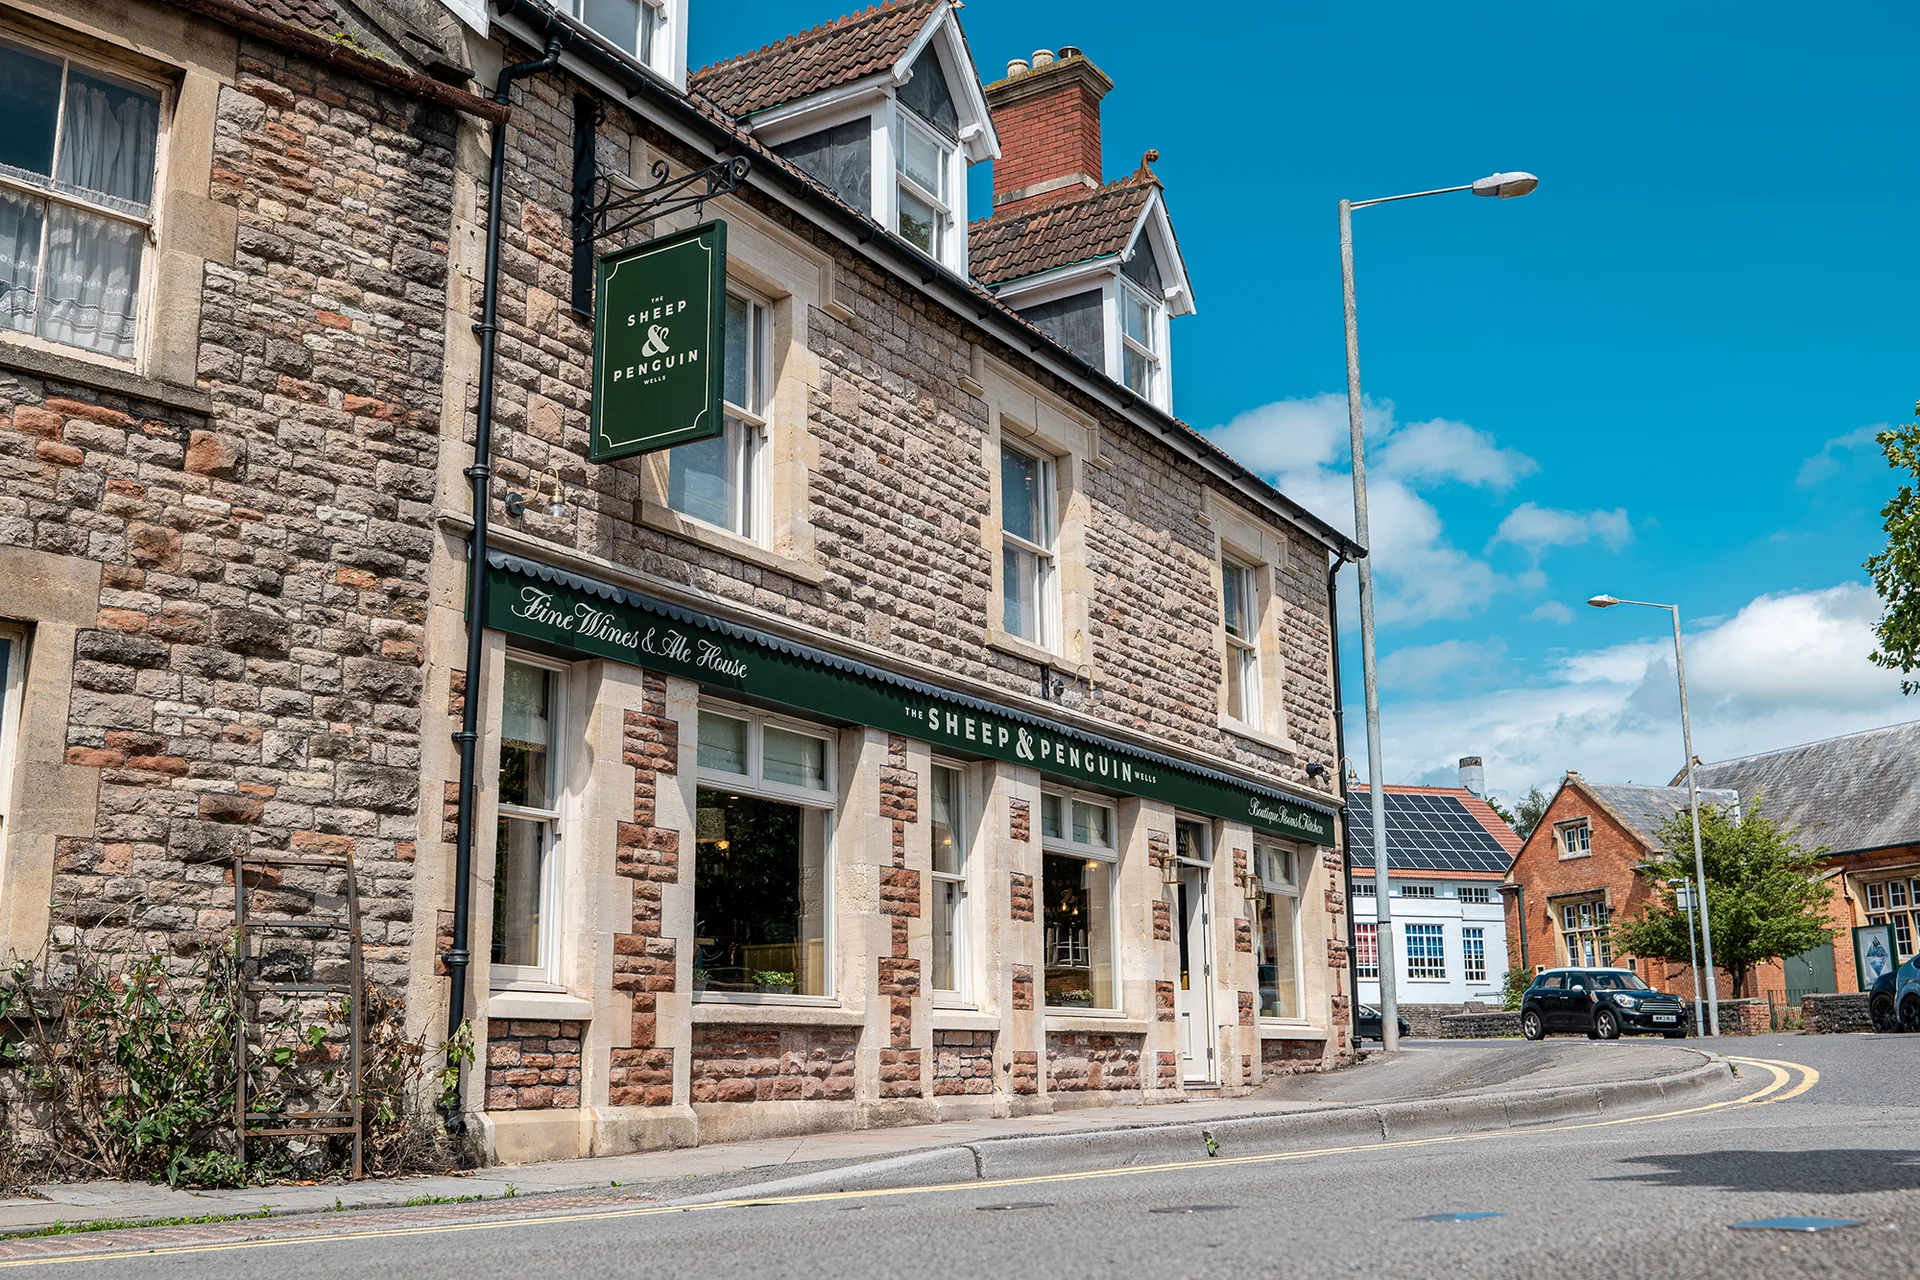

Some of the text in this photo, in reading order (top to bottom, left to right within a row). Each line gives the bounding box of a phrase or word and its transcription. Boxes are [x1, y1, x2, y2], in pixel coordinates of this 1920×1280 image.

[627, 300, 687, 327] SHEEP
[651, 295, 664, 303] THE
[641, 324, 670, 358] &
[613, 349, 698, 382] PENGUIN
[643, 375, 666, 385] WELLS
[511, 585, 748, 679] Fine Wines & Ale House
[905, 706, 1157, 784] THE SHEEP & PENGUIN WELLS
